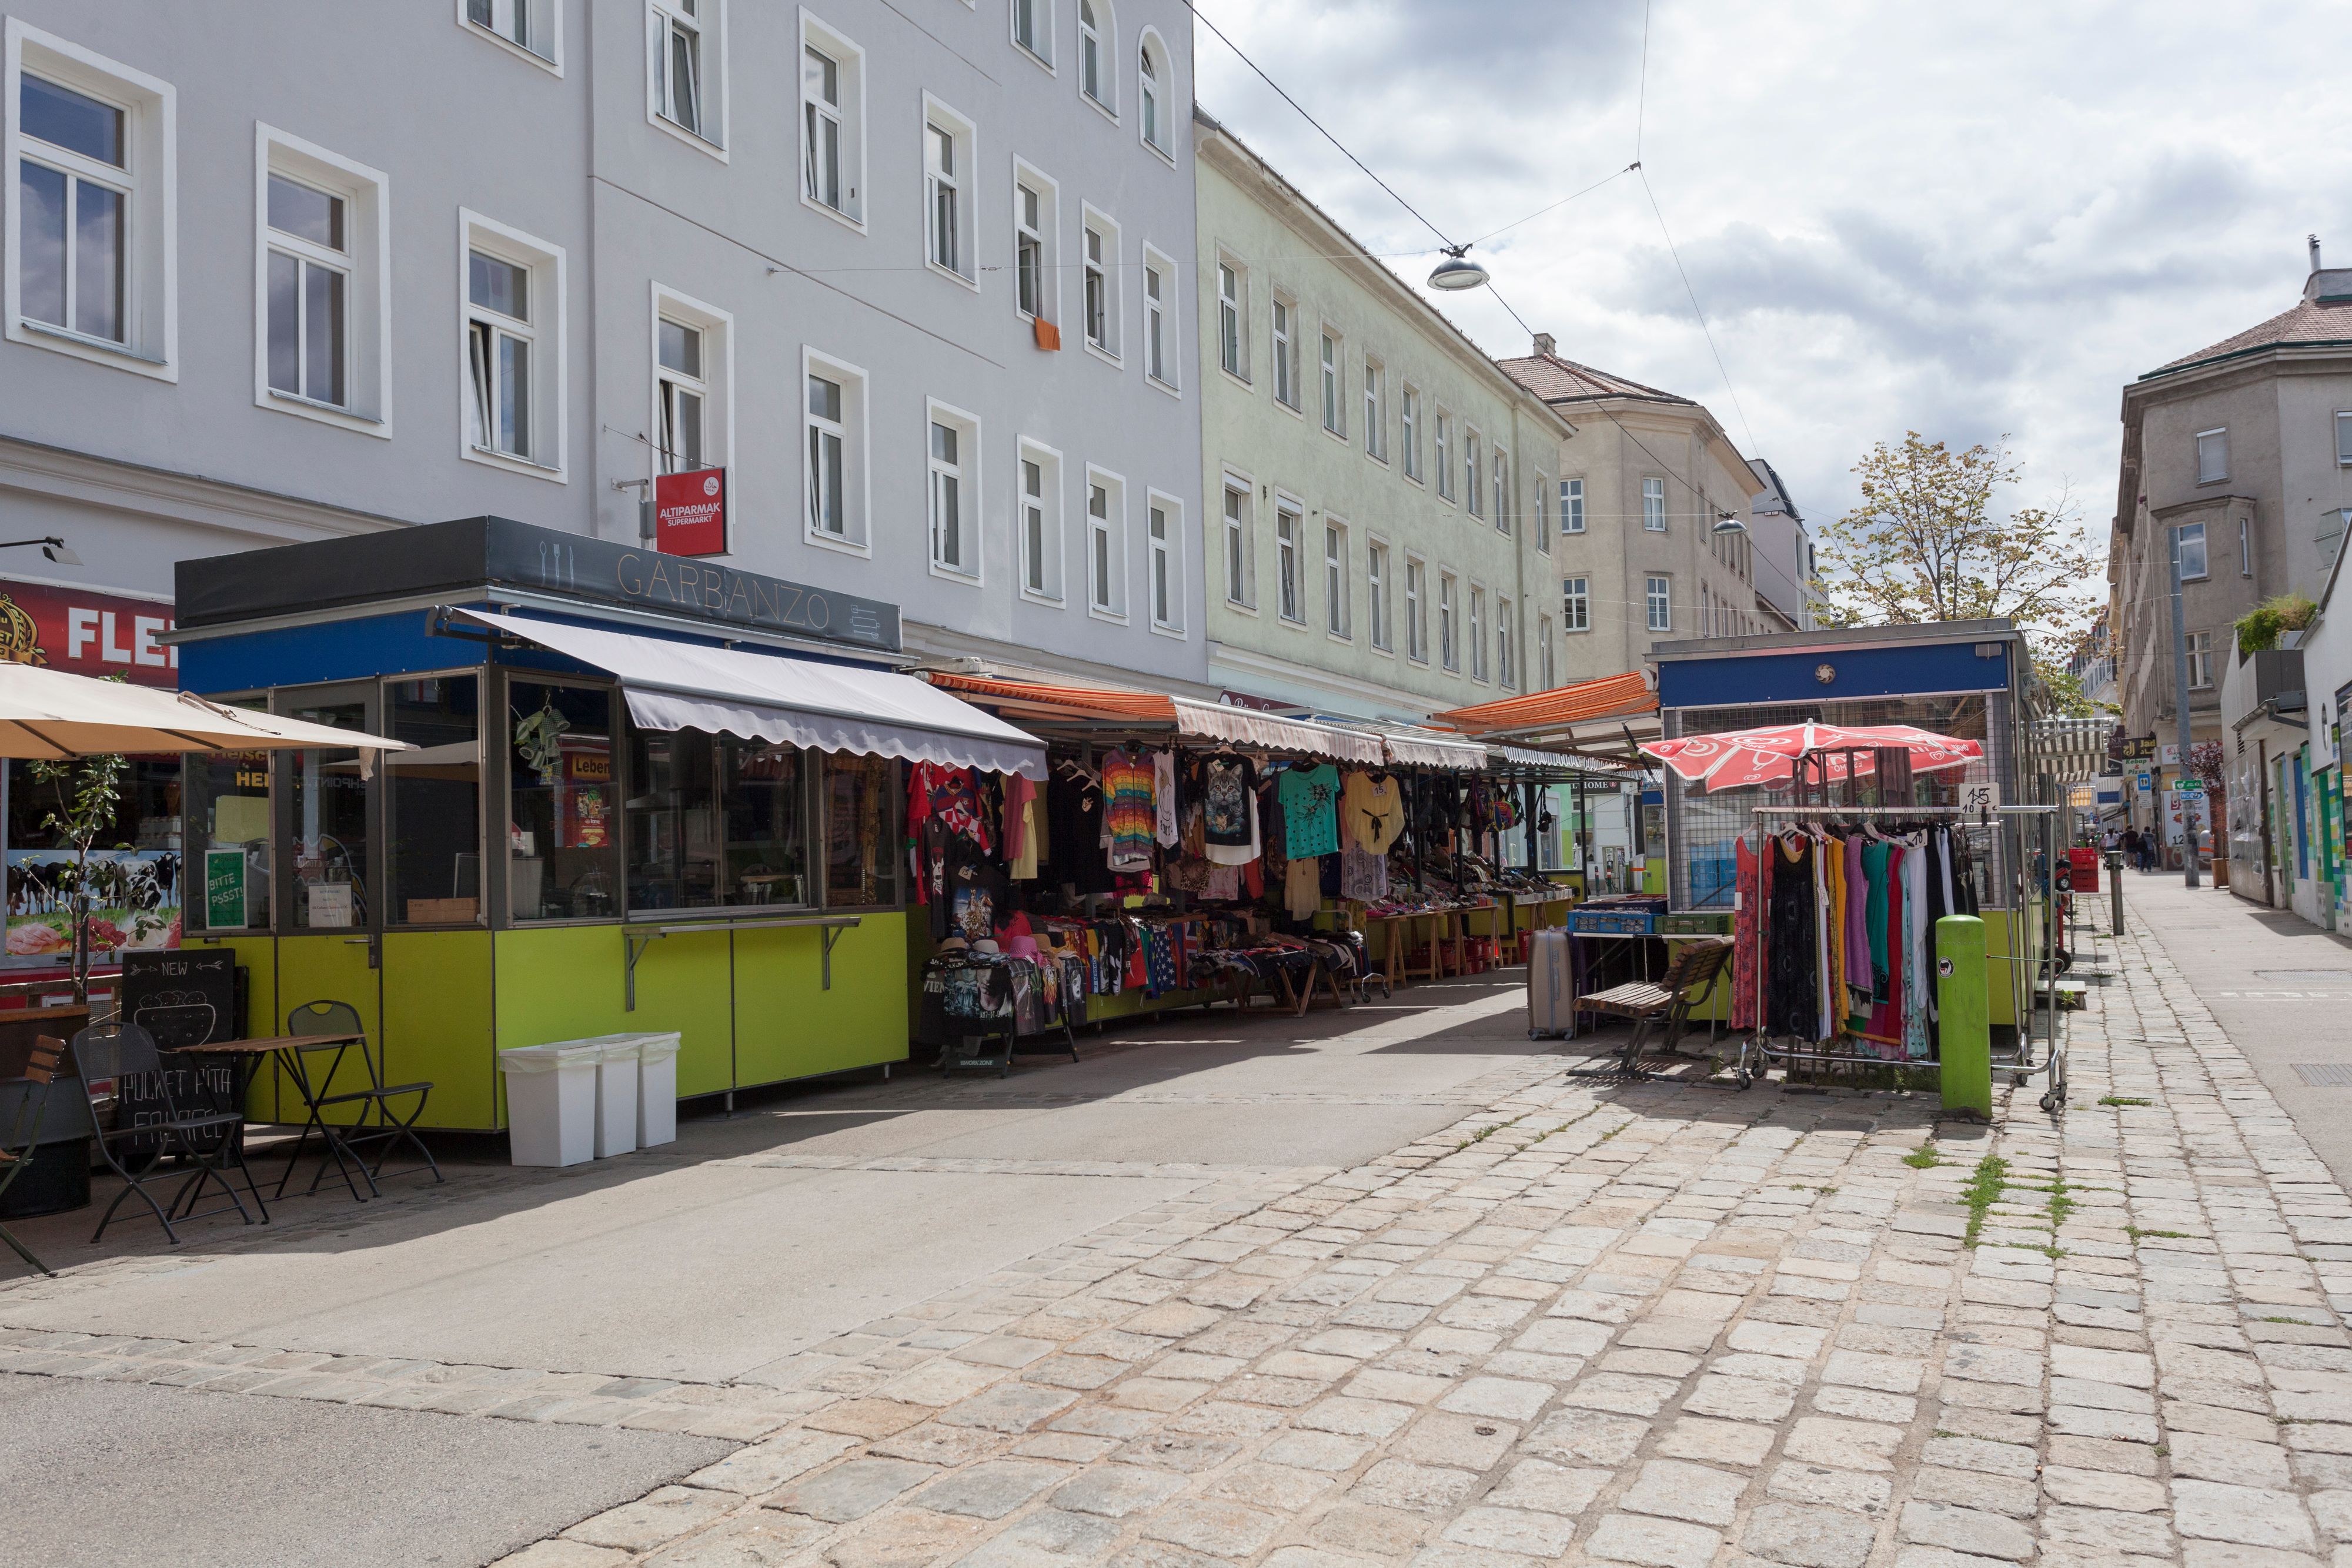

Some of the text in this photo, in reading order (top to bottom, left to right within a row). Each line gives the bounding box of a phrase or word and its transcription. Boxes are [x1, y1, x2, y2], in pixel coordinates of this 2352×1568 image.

[660, 502, 720, 519] ALTIPARMAK
[667, 516, 713, 527] SUPERMARKT
[617, 554, 829, 628] GARBANZO
[209, 872, 235, 891] BITTE
[212, 888, 243, 907] PSSST!
[162, 962, 188, 976] NEW
